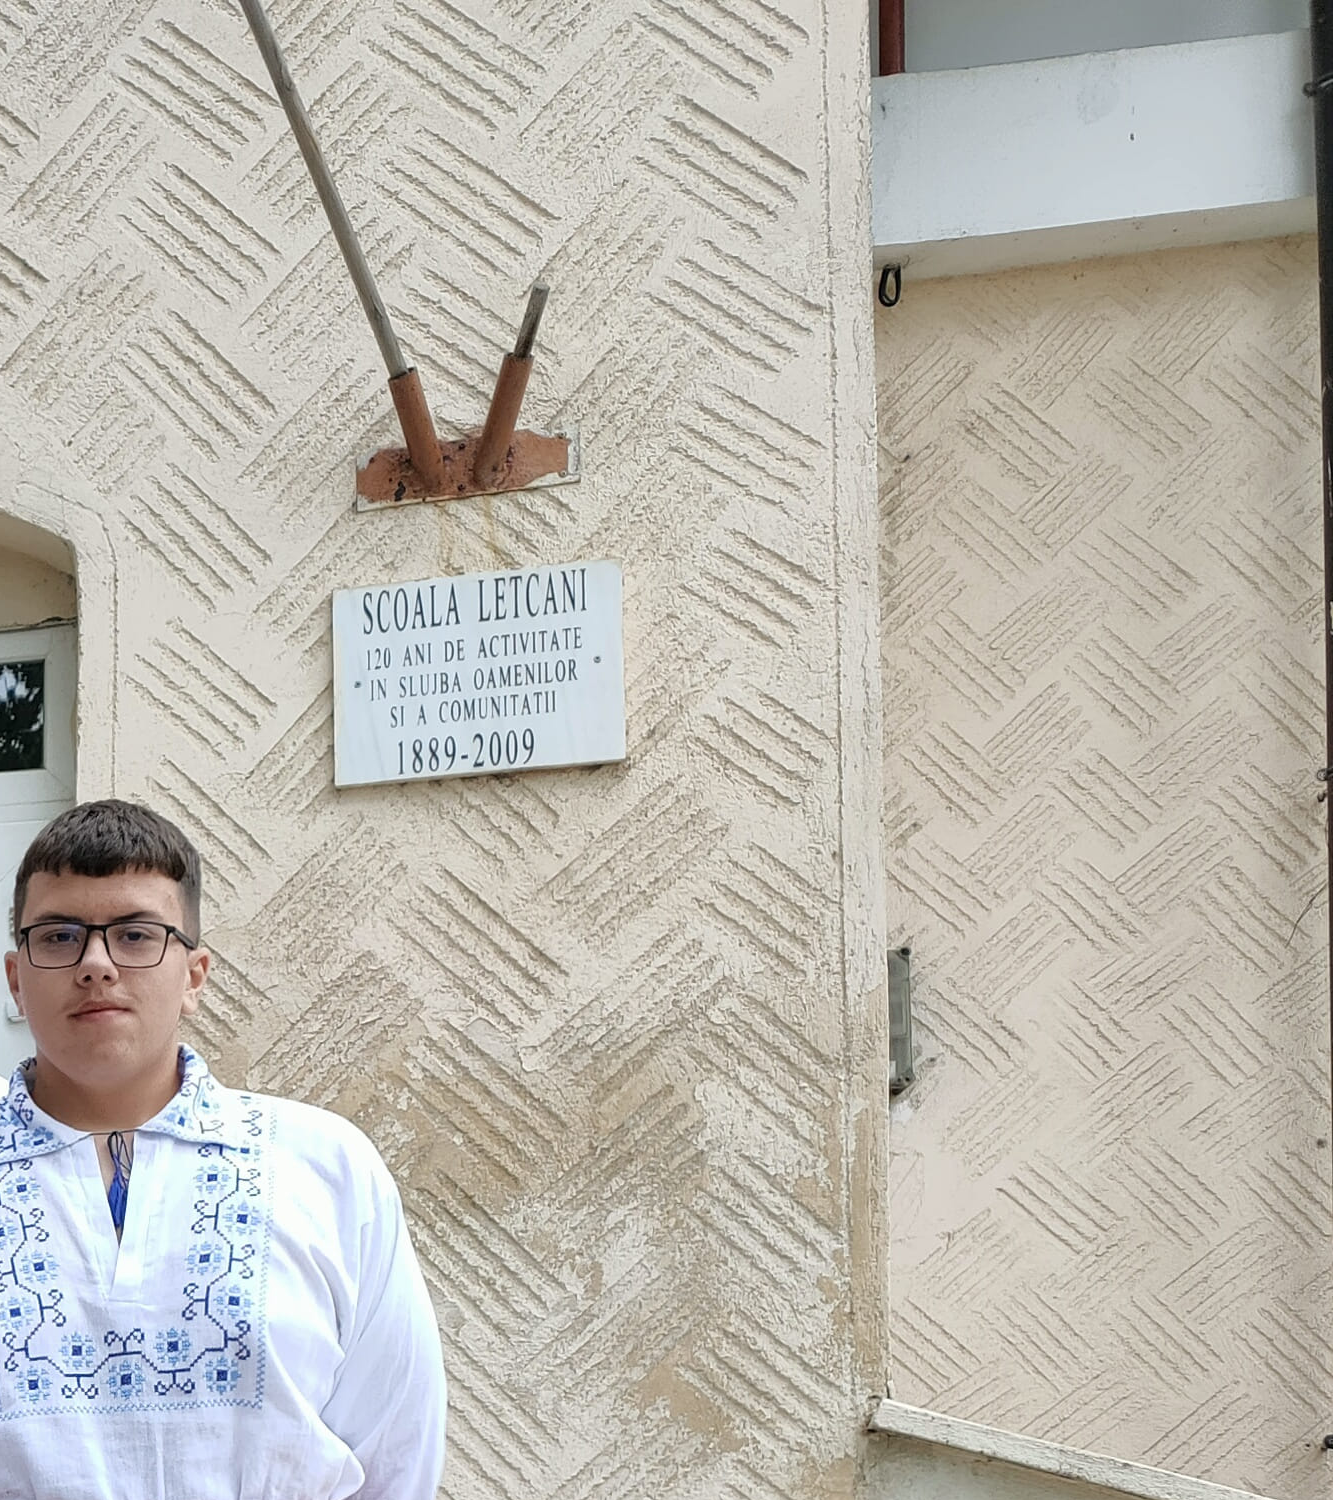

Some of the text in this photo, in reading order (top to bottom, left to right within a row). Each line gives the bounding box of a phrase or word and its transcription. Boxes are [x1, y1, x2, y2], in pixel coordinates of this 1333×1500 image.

[363, 568, 588, 635] SCOALA LETCANI
[366, 627, 583, 671] 120 ANI DE ACTIVITATE
[370, 659, 579, 701] IN SLUJBA OAMENILOR
[390, 690, 557, 728] SI A COMUNITATII
[398, 728, 536, 775] 1889-2009
